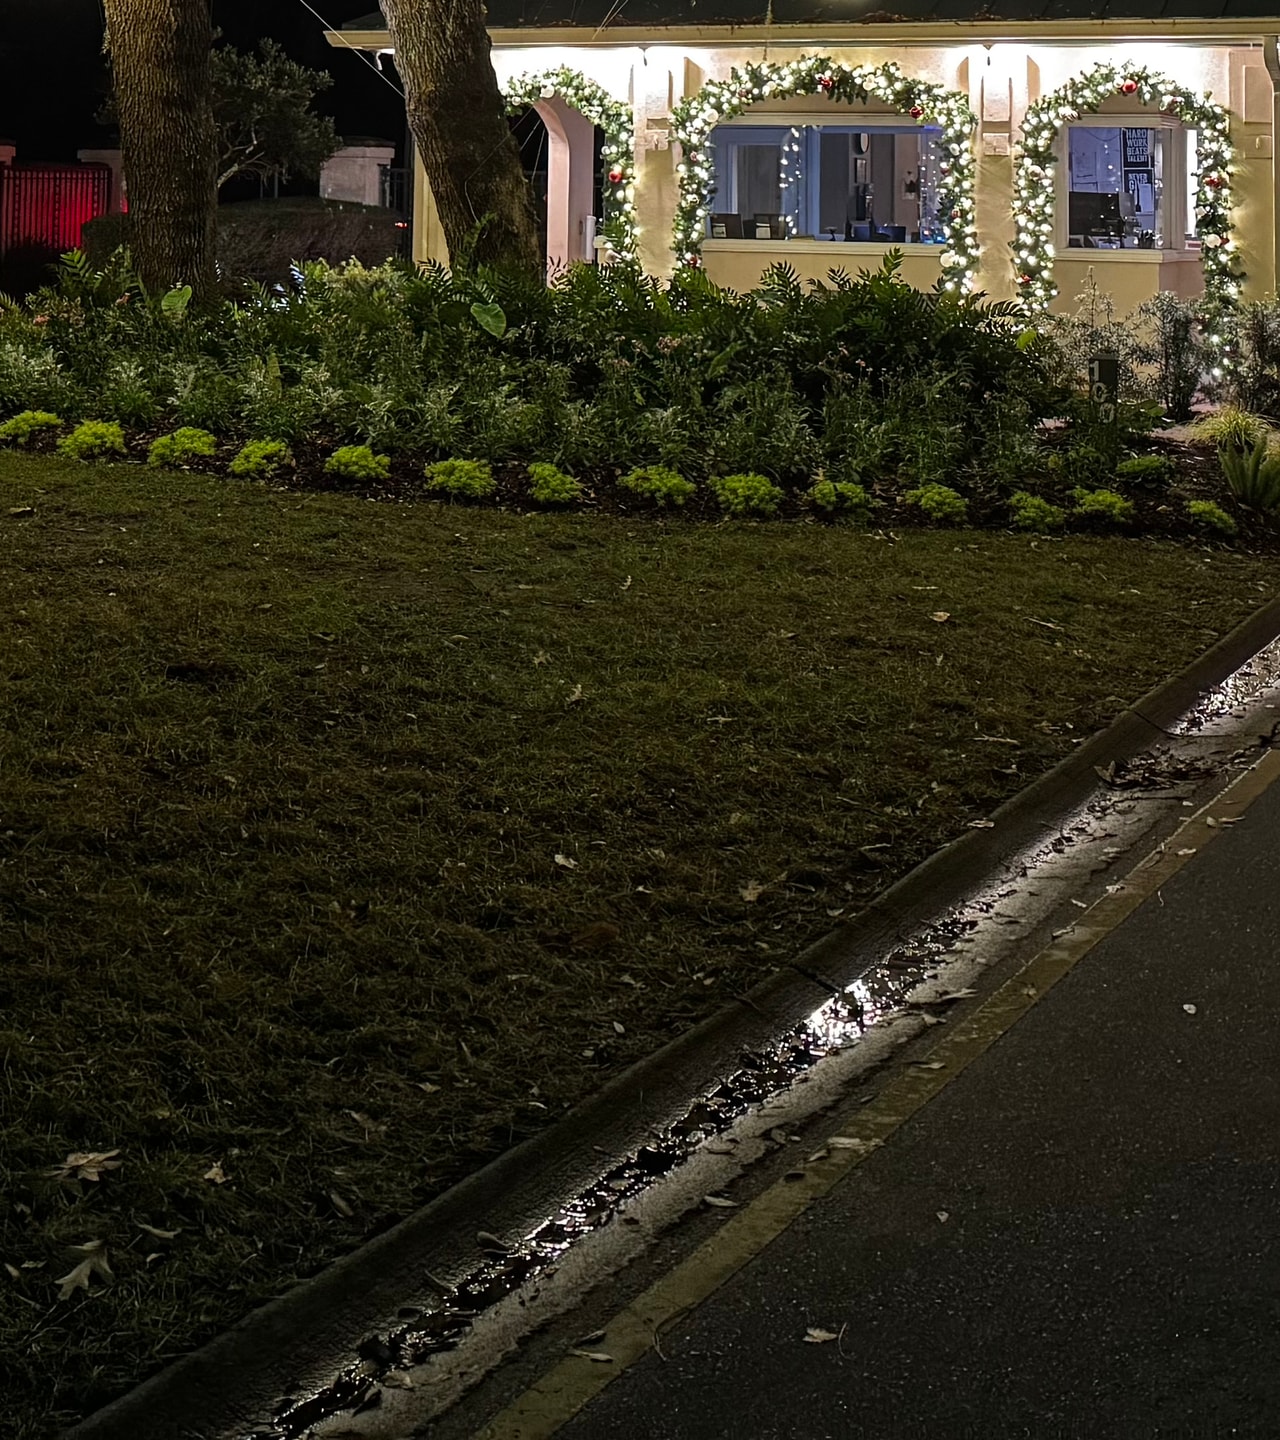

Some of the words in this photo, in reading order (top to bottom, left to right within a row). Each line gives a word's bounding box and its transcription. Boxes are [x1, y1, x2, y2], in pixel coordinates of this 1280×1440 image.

[1126, 129, 1147, 138] HARD
[1127, 139, 1148, 147] WORK
[1127, 147, 1148, 155] BEATS
